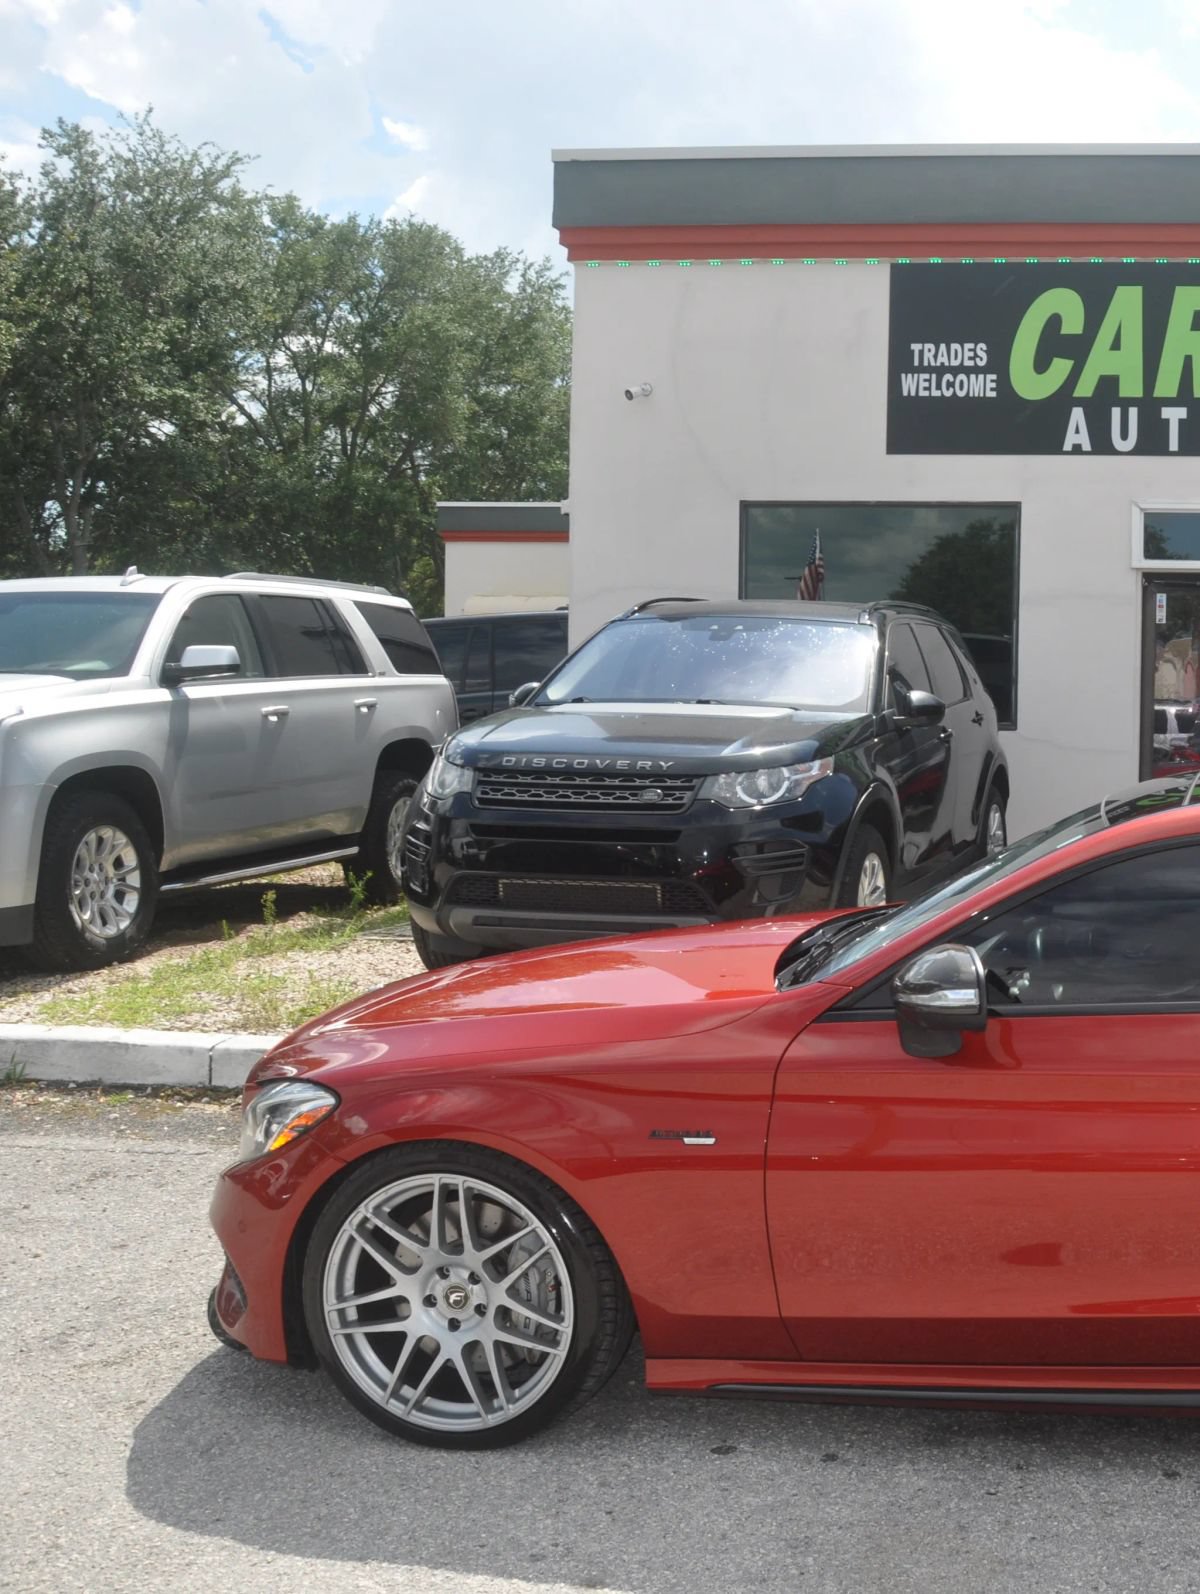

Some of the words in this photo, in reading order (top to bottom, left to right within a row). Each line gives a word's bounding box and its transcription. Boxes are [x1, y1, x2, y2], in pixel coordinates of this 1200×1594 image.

[910, 342, 988, 368] TRADES
[900, 372, 997, 398] WELCOME
[502, 756, 676, 771] DISCOVERY
